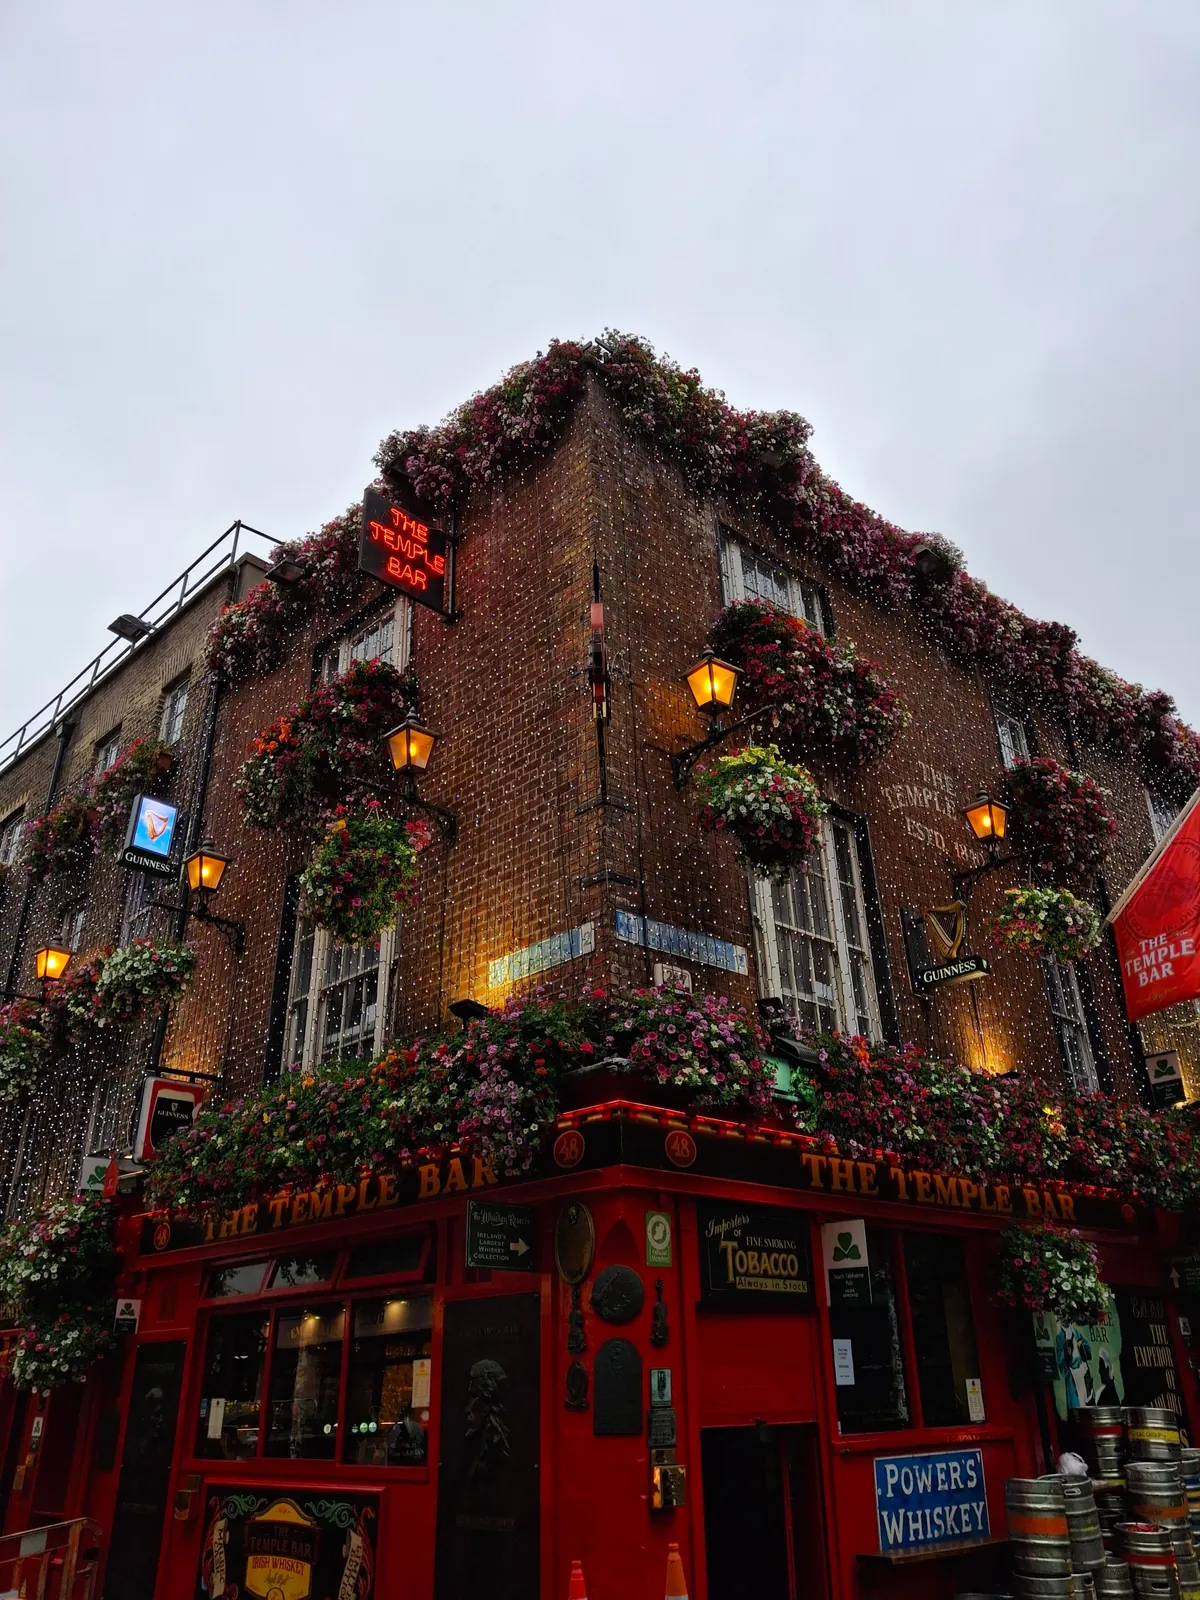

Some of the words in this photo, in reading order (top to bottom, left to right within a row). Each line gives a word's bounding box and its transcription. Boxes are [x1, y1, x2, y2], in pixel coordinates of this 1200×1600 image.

[390, 507, 429, 544] THE
[369, 521, 446, 575] TEMPLE
[387, 556, 427, 590] BAR
[918, 761, 956, 797] THE
[881, 784, 957, 820] TEMPLE
[124, 851, 171, 873] GUINNESS
[583, 931, 592, 946] 2
[1139, 933, 1168, 953] THE
[1125, 938, 1196, 978] TEMPLE
[923, 959, 977, 983] GUINNESS
[1138, 962, 1174, 987] BAR
[157, 1109, 189, 1120] GUINNESS
[559, 1137, 579, 1161] 48
[670, 1136, 690, 1158] 48
[269, 1175, 400, 1229] TEMPLE
[418, 1157, 498, 1200] BAR
[802, 1153, 879, 1196] THE
[890, 1167, 1013, 1214] TEMPLE
[1023, 1183, 1077, 1221] BAR
[155, 1227, 168, 1245] 48
[476, 1231, 507, 1240] IRELAND'S
[704, 1213, 751, 1239] Importers
[733, 1228, 743, 1237] OF
[478, 1239, 505, 1247] LARGEST
[478, 1246, 505, 1254] WHISKEY
[745, 1236, 764, 1247] FINE
[763, 1237, 798, 1250] SMOKING
[473, 1252, 510, 1261] COLLECTION
[719, 1239, 799, 1285] TOBACCO
[737, 1277, 769, 1289] Always
[771, 1279, 780, 1289] in
[782, 1280, 807, 1291] Stock
[1089, 1327, 1110, 1344] BAR
[1148, 1323, 1169, 1345] THE
[1133, 1346, 1174, 1368] EMPEROR
[1165, 1368, 1177, 1390] OF
[273, 1526, 290, 1538] THE
[880, 1501, 985, 1545] WHISKEY
[250, 1536, 289, 1554] TEMPLE
[291, 1540, 312, 1560] BAR
[252, 1556, 270, 1569] IRISH
[272, 1557, 306, 1577] WHISKEY
